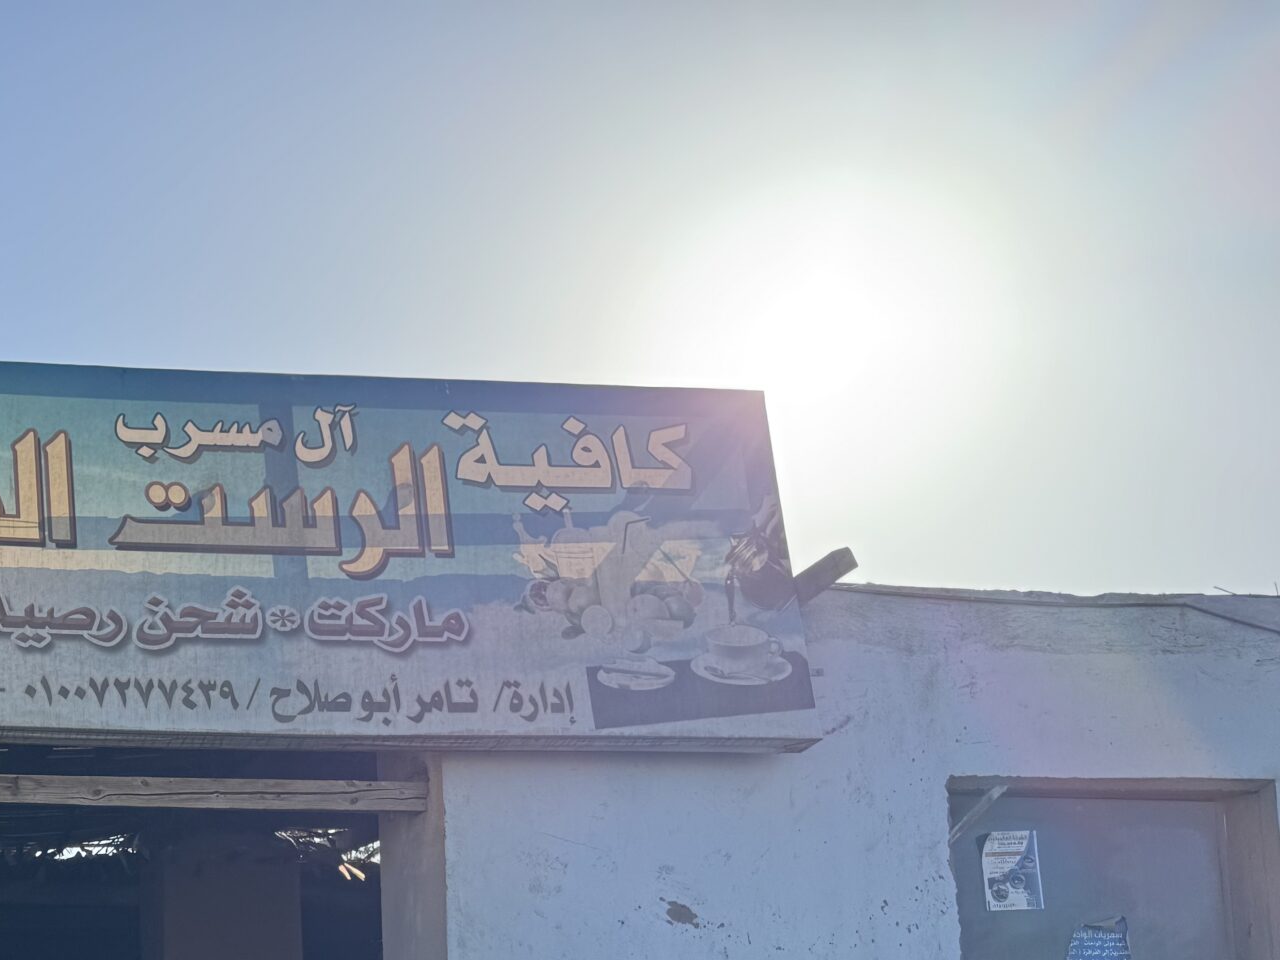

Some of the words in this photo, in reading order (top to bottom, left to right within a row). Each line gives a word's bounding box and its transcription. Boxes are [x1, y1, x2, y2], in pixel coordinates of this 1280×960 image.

[115, 412, 284, 461] مسرب
[294, 403, 357, 464] آل
[443, 409, 692, 512] كافية
[108, 442, 455, 578] الرست
[135, 587, 261, 649] شحن
[307, 595, 468, 650] ماركت
[406, 677, 479, 724] تامر
